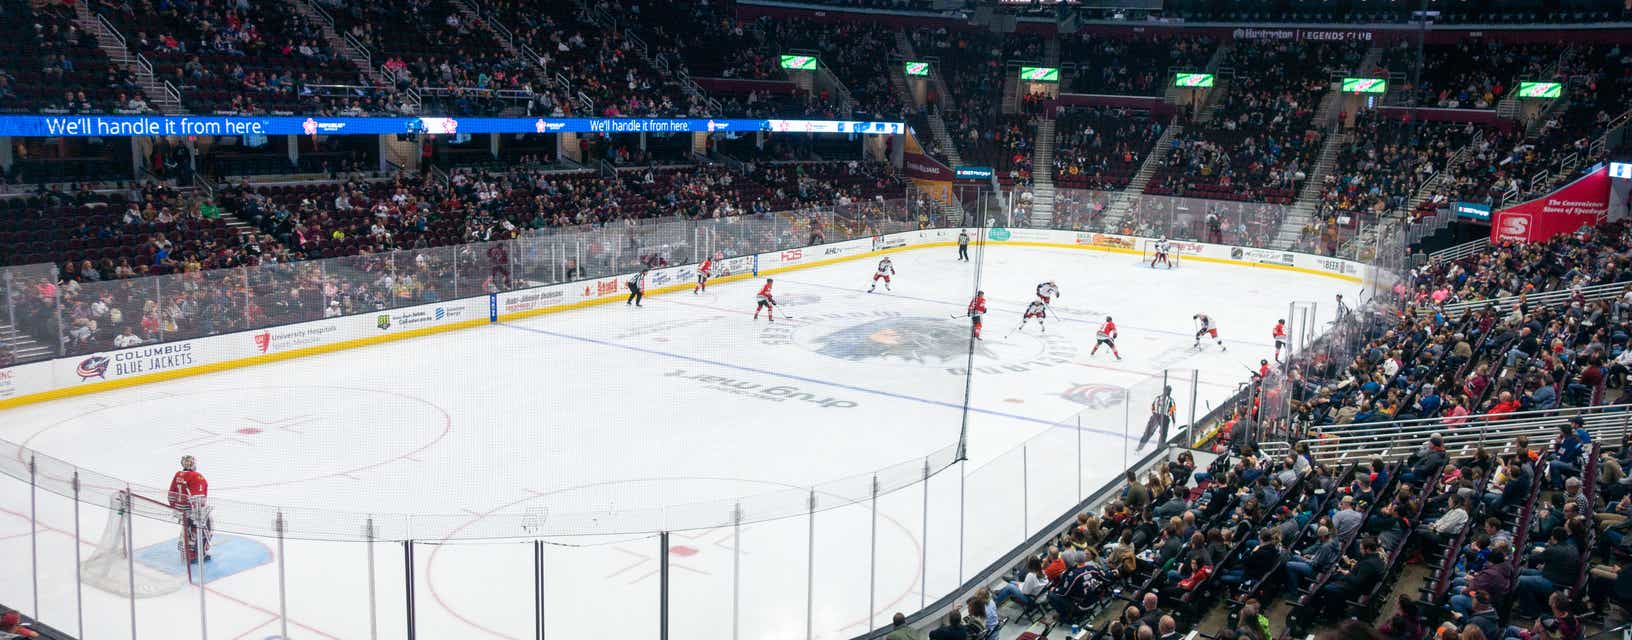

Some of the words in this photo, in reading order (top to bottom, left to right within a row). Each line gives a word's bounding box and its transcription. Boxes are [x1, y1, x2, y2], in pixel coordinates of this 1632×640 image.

[1303, 31, 1344, 40] LEGENDS
[46, 118, 91, 134] We'll
[98, 118, 159, 134] handle
[165, 118, 176, 134] it
[181, 118, 221, 134] from
[590, 120, 610, 131] We'll
[613, 120, 640, 131] handle
[642, 120, 648, 131] it
[650, 120, 668, 131] from
[272, 331, 304, 341] University
[308, 325, 336, 335] Hospitals
[115, 343, 192, 362] COLUMBUS
[116, 359, 143, 376] BLUE
[149, 353, 193, 370] JACKETS
